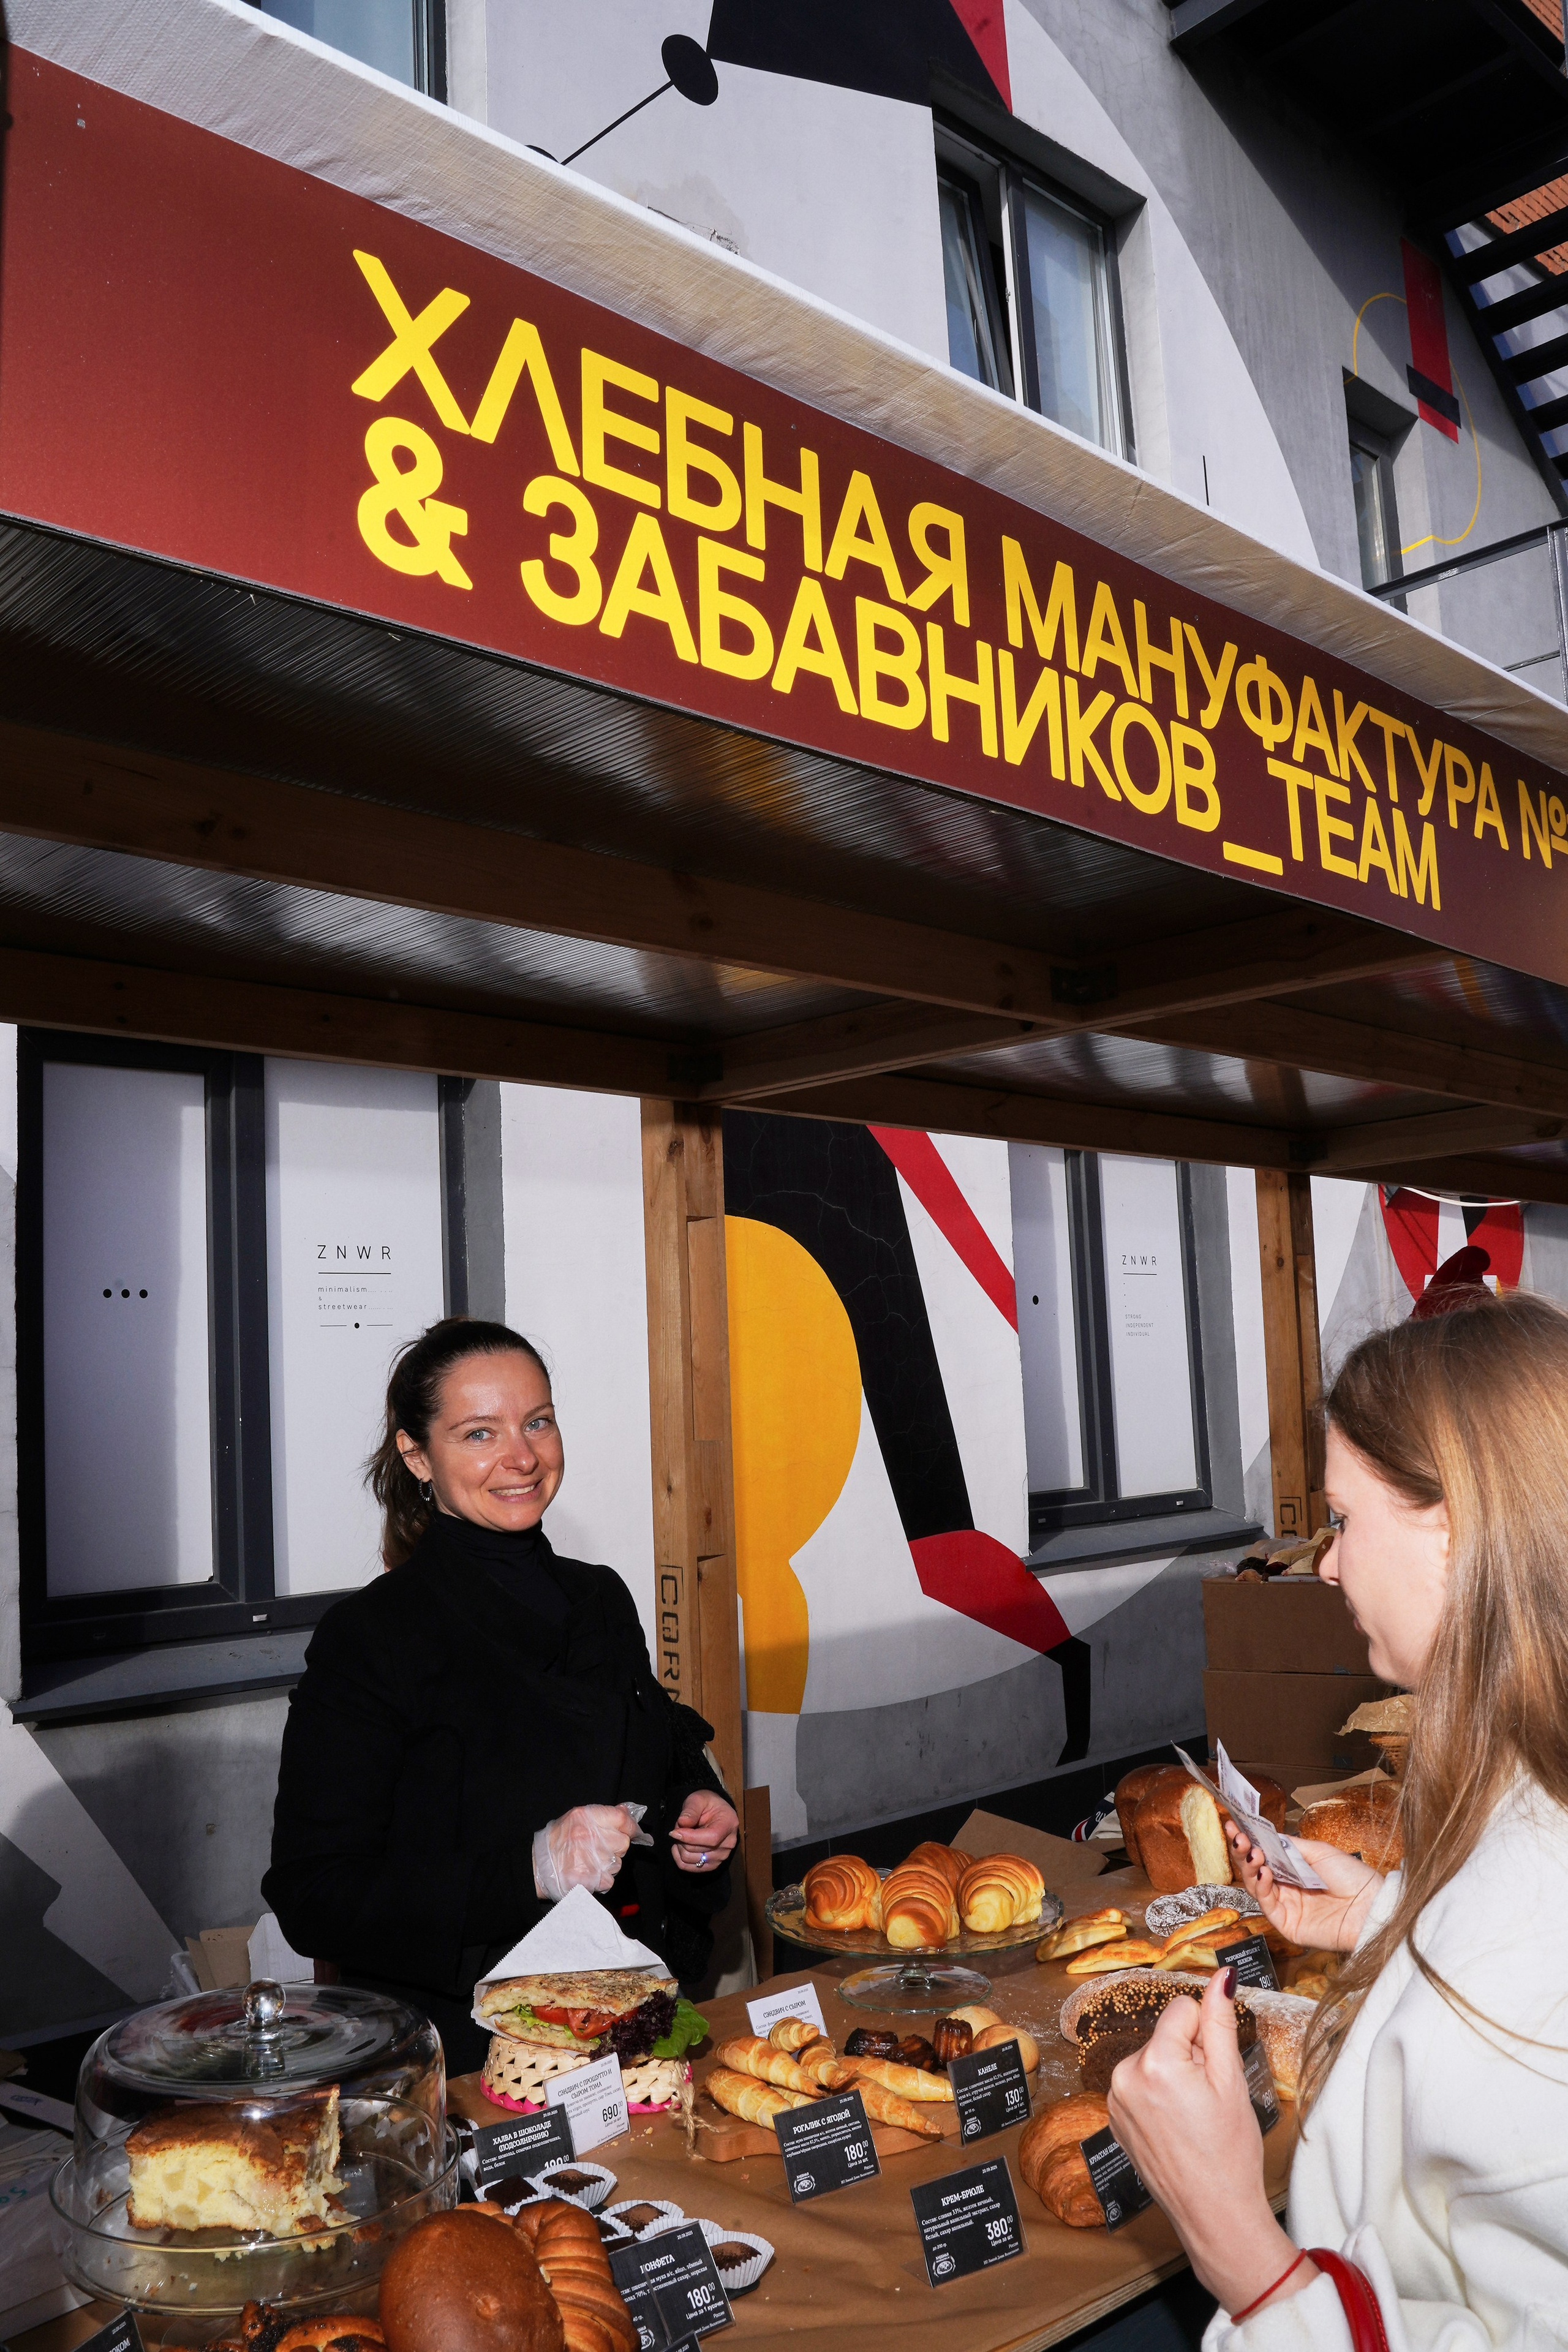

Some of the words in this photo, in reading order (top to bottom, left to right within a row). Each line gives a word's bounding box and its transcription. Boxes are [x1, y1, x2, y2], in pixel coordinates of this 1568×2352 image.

[357, 417, 473, 590] &
[352, 249, 970, 628] ХЛЕБНАЯ
[1001, 535, 1509, 851] МАНУФАКТУРА
[317, 1245, 391, 1259] ZNWR
[1122, 1255, 1157, 1265] ZNWR
[1259, 1975, 1270, 1988] 190
[763, 2007, 785, 2018] СЭНДВИЧ
[789, 2000, 805, 2010] СЫРОМ
[978, 2063, 997, 2075] КАНЕЛЕ
[557, 2083, 579, 2097] СЭНДВИЧ
[583, 2070, 607, 2086] ПРОШУТТО
[571, 2087, 588, 2099] СЫРОМ
[589, 2081, 602, 2091] ТОМА
[1005, 2089, 1019, 2105] 130
[1262, 2089, 1273, 2108] 260
[602, 2104, 618, 2122] 690
[793, 2120, 821, 2134] РОГАЛИК
[826, 2109, 850, 2124] ЯГОДОЙ
[492, 2133, 513, 2145] ХАЛВА
[518, 2120, 551, 2136] ШОКОЛАДЕ
[845, 2143, 863, 2161] 180
[1089, 2148, 1109, 2165] КРУАССАН
[941, 2185, 984, 2206] КРЕМ-БРЮЛЕ
[921, 2217, 937, 2225] Состав:
[924, 2220, 949, 2233] натуральный
[950, 2212, 971, 2224] ванильный
[986, 2218, 1008, 2239] 380
[1006, 2215, 1013, 2223] 00
[677, 2230, 693, 2239] 20.09.2025
[631, 2278, 655, 2291] пшеничая
[687, 2258, 703, 2269] тёмный
[690, 2266, 707, 2275] морская
[687, 2286, 710, 2308] 180
[707, 2282, 715, 2291] 00
[707, 2301, 723, 2310] кусочек
